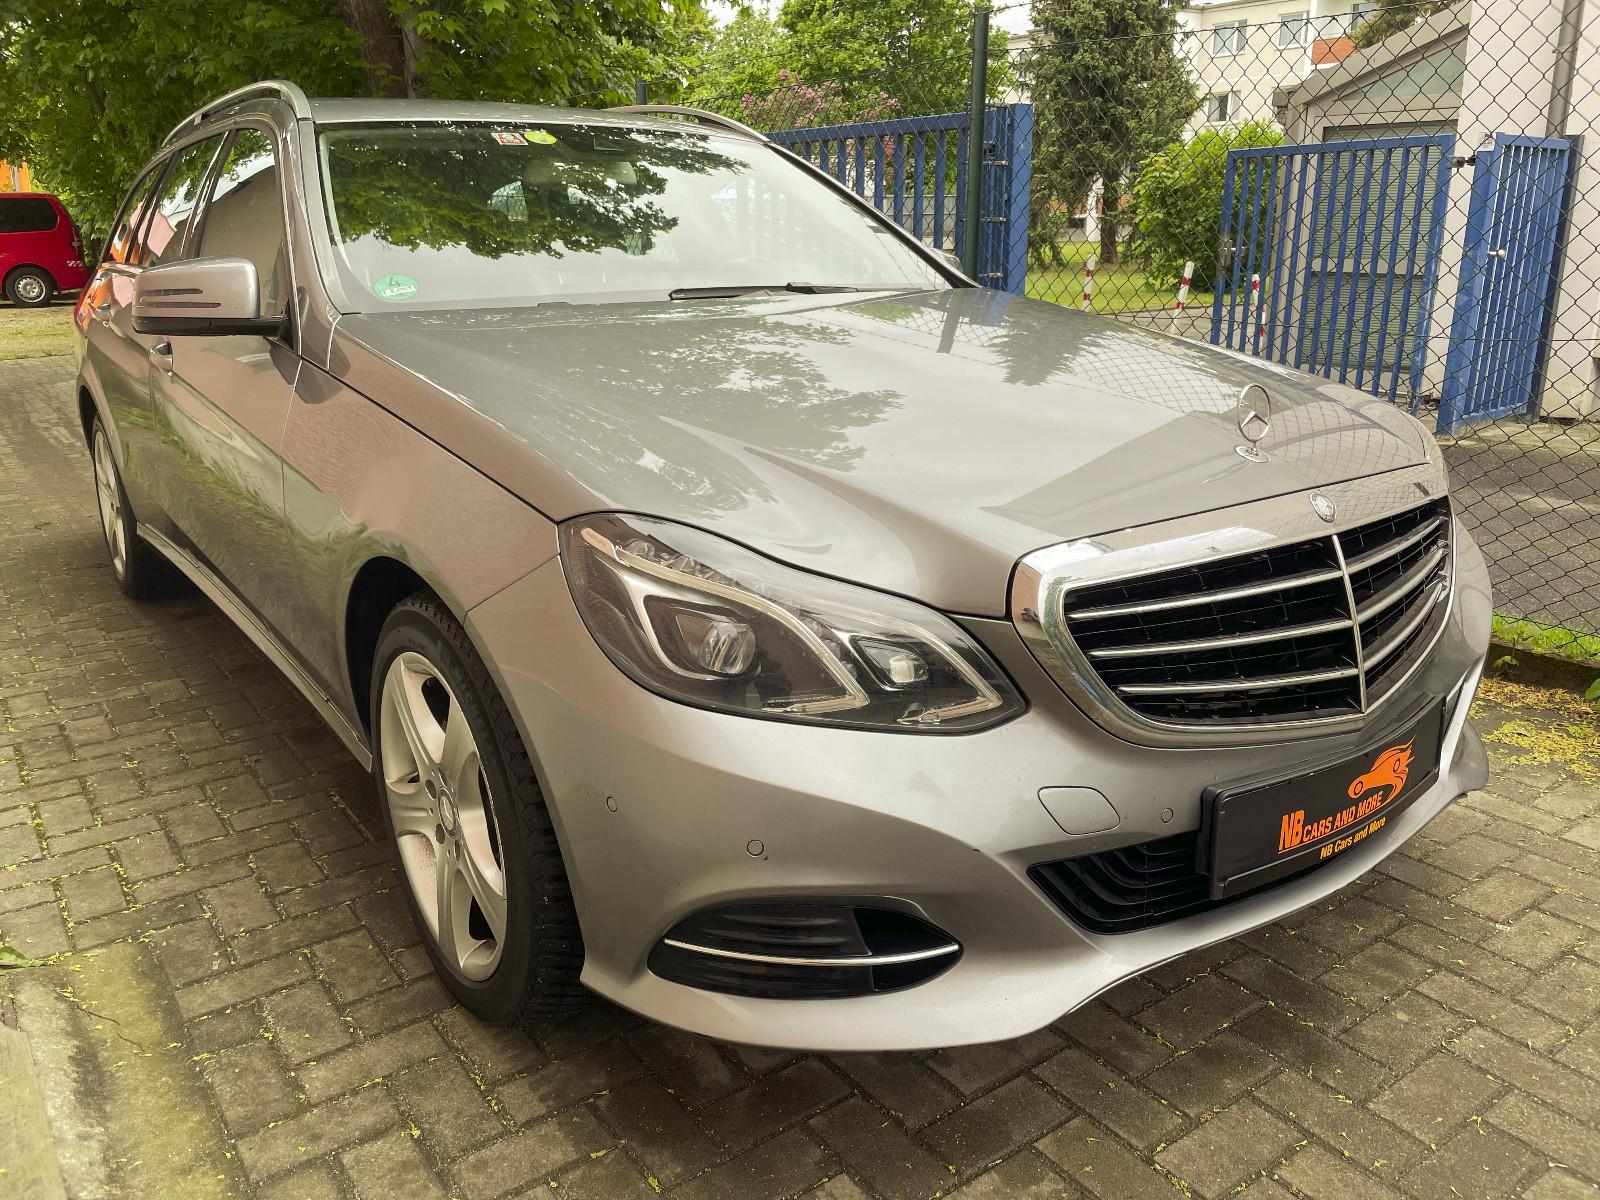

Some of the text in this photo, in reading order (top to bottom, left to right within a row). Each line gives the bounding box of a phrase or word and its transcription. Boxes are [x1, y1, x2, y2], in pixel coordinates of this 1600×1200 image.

[1279, 791, 1383, 850] NB CARS AND MORE
[1320, 817, 1385, 859] NB Cars and More
